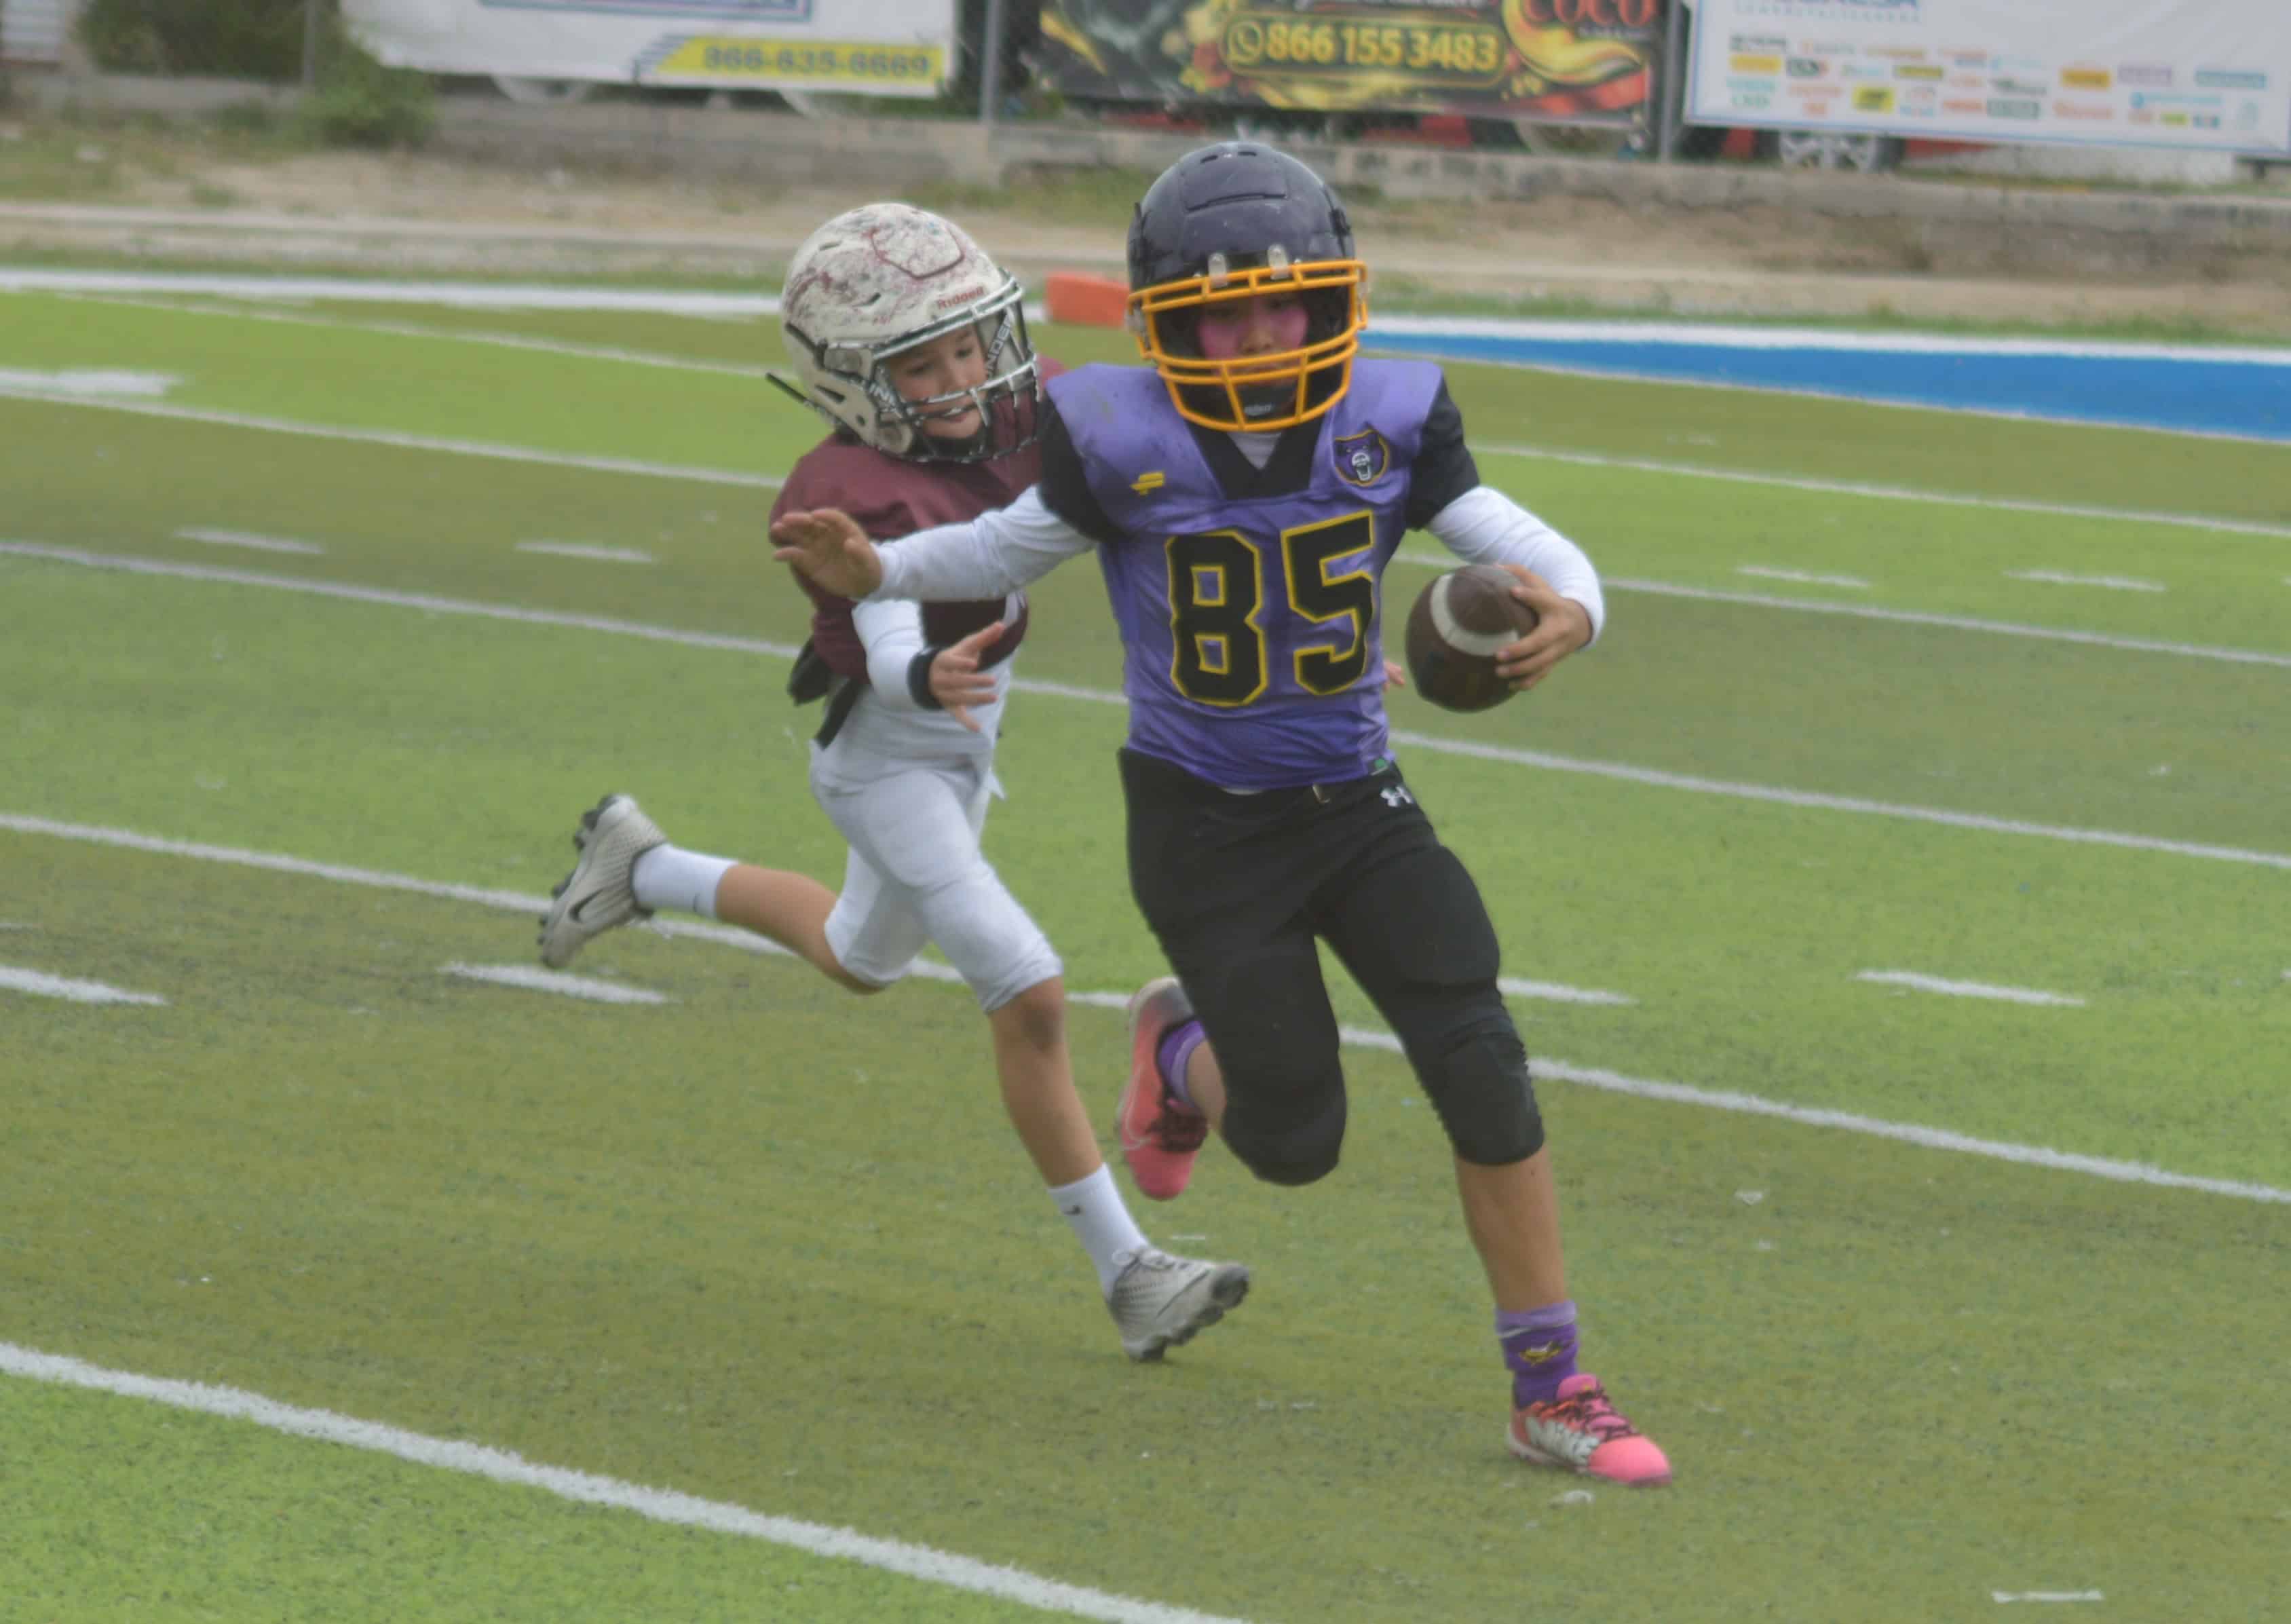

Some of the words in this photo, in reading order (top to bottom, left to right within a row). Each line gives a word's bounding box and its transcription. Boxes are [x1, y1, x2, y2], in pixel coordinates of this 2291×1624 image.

[1266, 22, 1335, 64] 866
[1340, 26, 1401, 67] 155
[1405, 31, 1499, 73] 3483
[1165, 510, 1374, 708] 85
